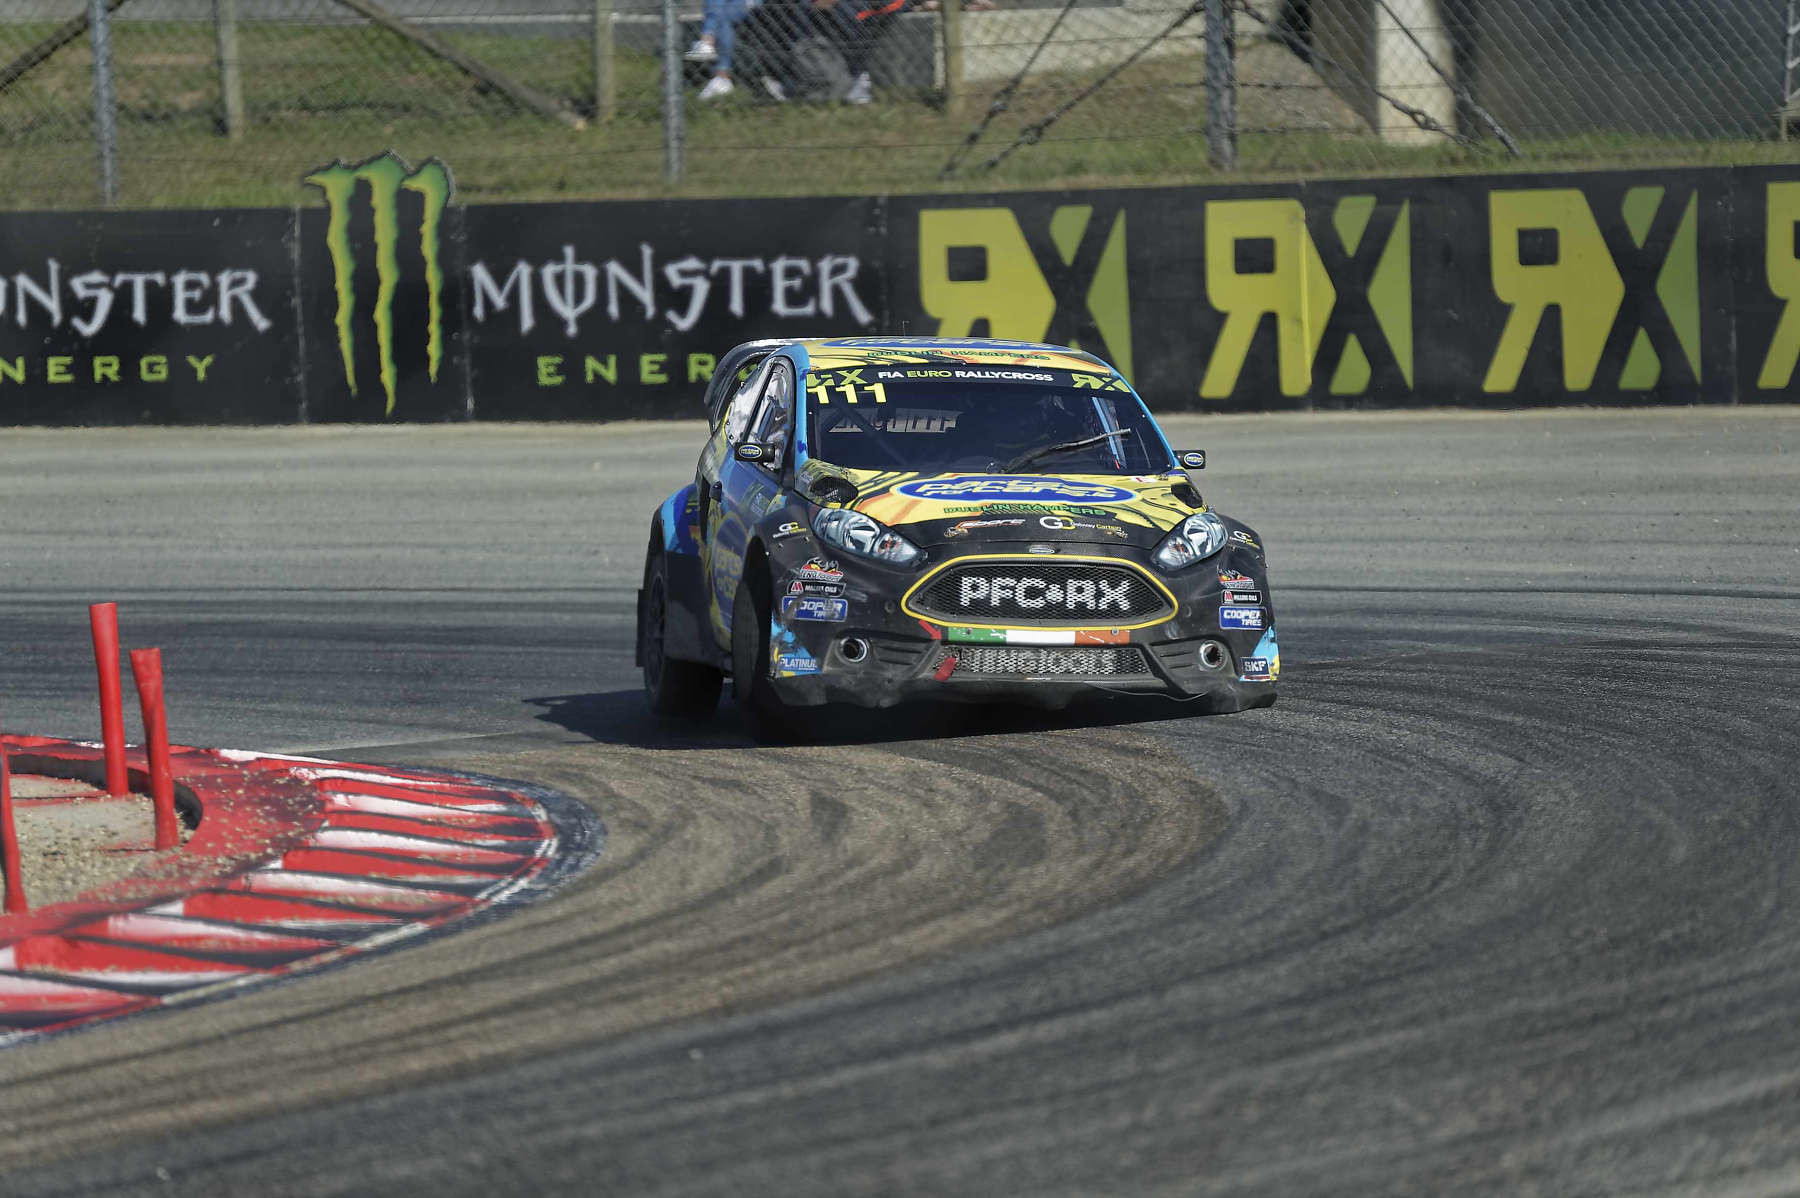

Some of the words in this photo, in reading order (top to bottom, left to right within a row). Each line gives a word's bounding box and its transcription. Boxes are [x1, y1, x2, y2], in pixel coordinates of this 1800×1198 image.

[878, 371, 904, 379] FIA
[907, 370, 952, 378] EURO
[955, 370, 1054, 381] RALLYCROSS
[807, 383, 887, 404] 111
[943, 503, 1010, 513] DUBLIN
[1020, 504, 1106, 515] HAMPERS
[1244, 660, 1266, 672] SKF
